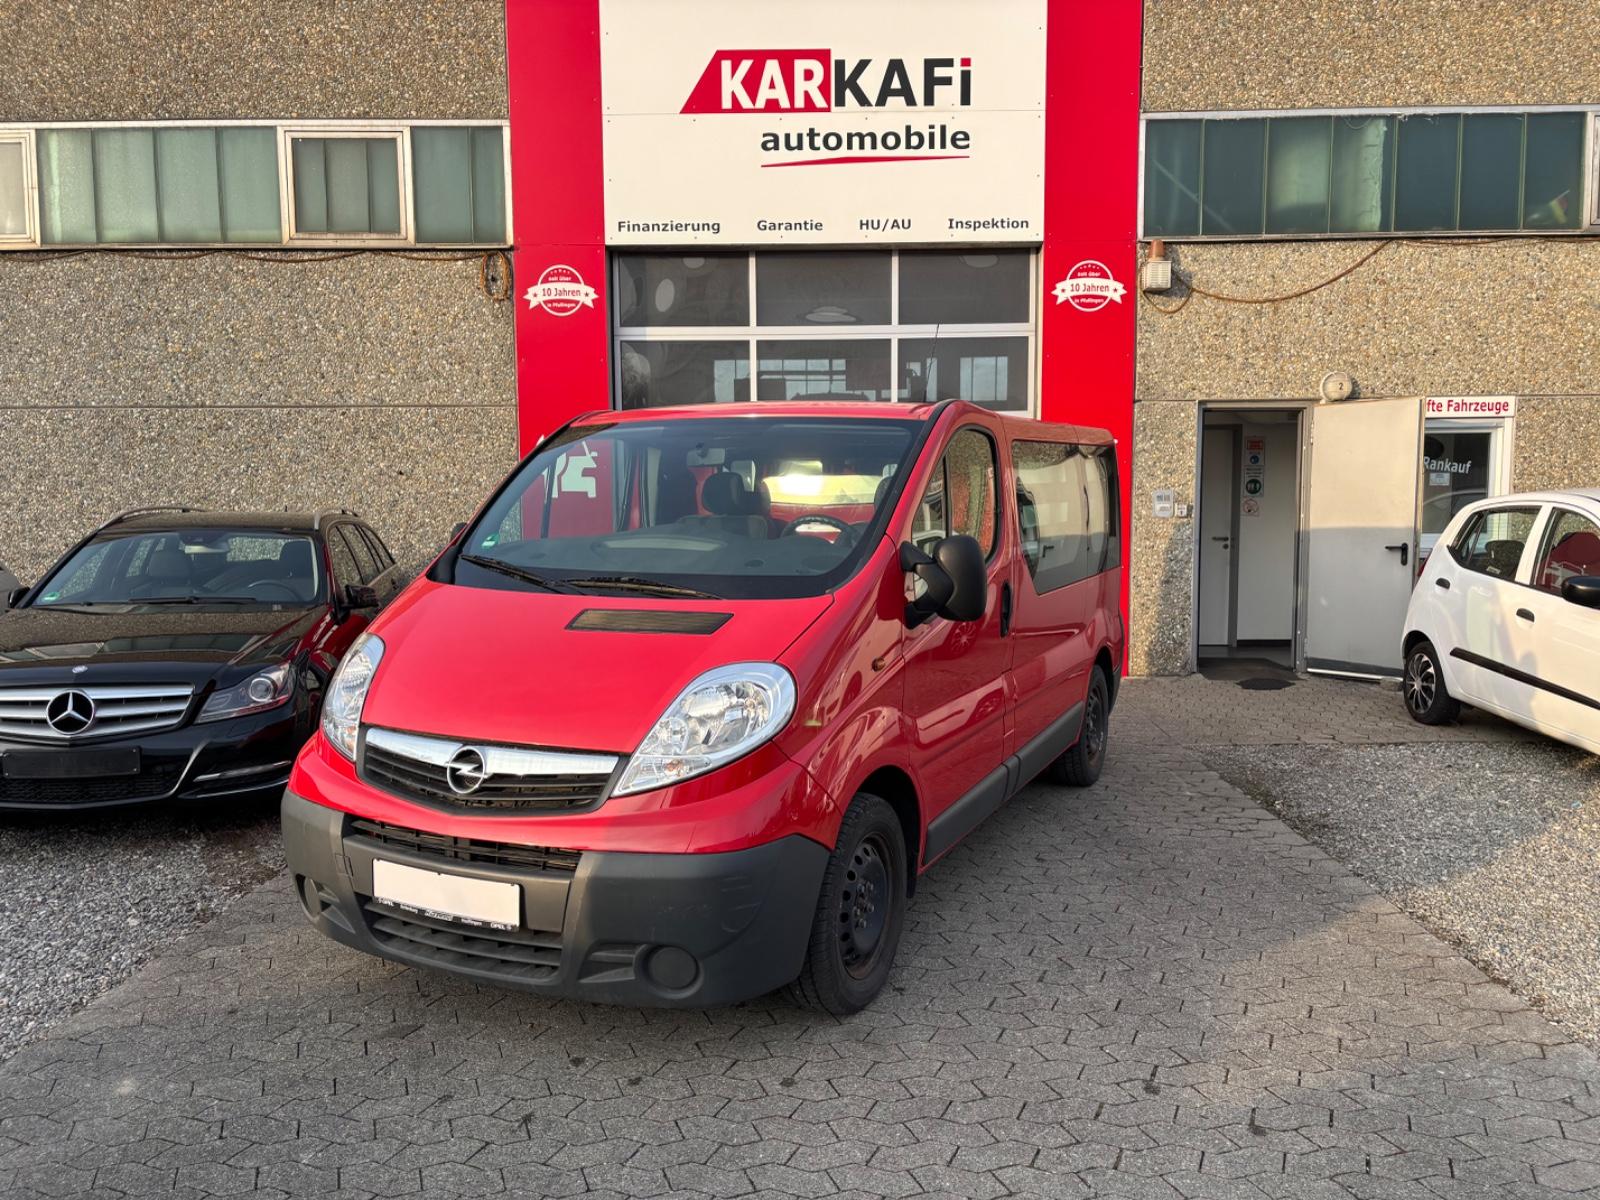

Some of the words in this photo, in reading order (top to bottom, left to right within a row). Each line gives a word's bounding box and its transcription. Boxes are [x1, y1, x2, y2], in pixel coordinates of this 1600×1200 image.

[760, 124, 971, 152] automobile
[617, 219, 721, 235] Finanzierung
[756, 217, 824, 232] Garantie
[859, 218, 912, 232] HU/AU
[947, 216, 1030, 233] Inspektion
[542, 287, 552, 297] 10
[554, 287, 581, 297] Jahren
[1070, 283, 1080, 292] 10
[1082, 283, 1110, 292] Jahren
[1447, 399, 1509, 414] Fahrzeuge
